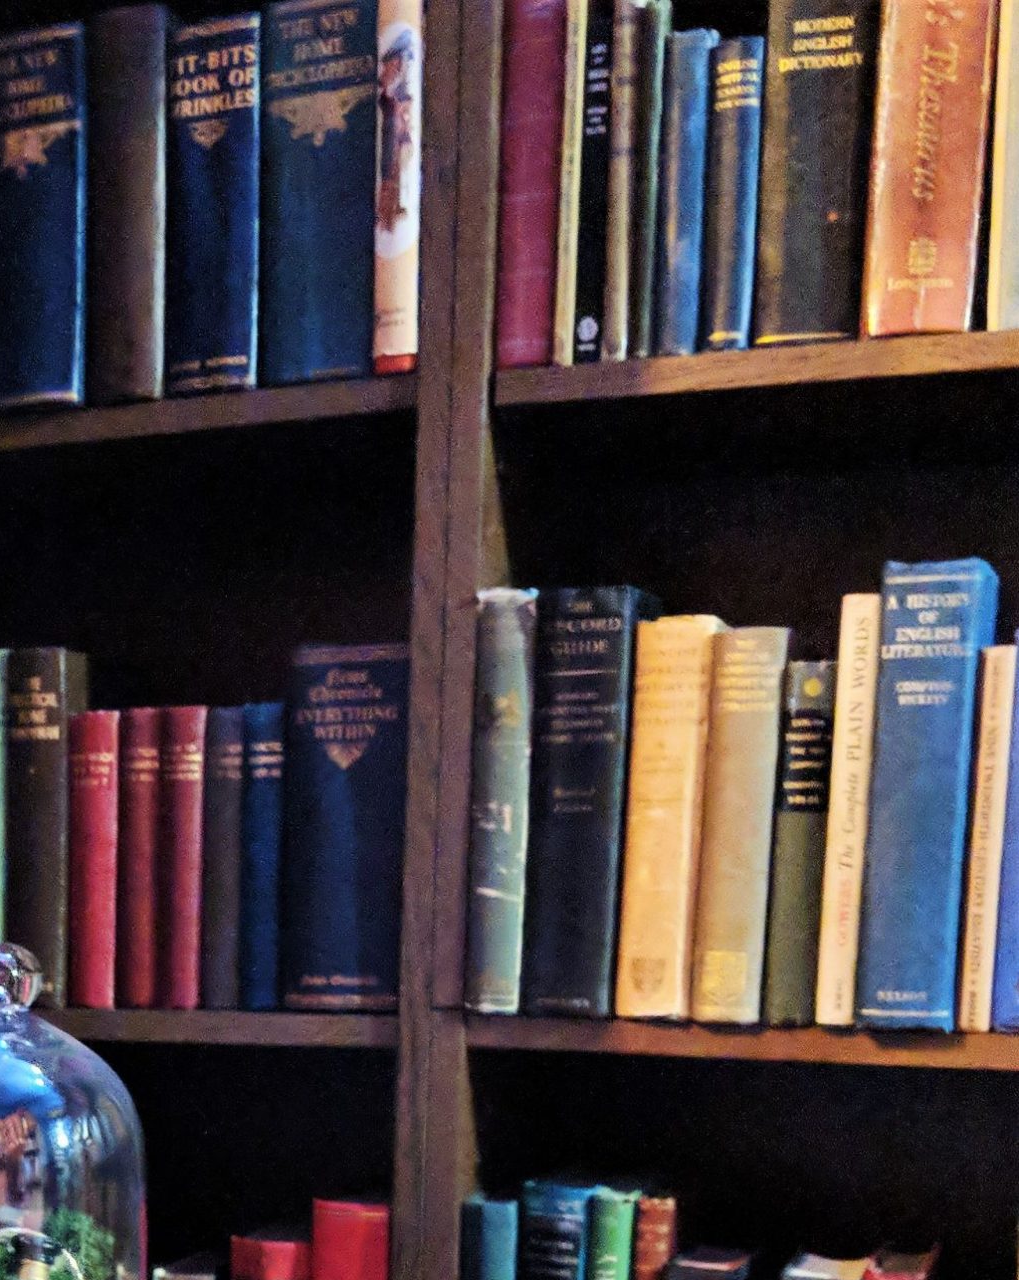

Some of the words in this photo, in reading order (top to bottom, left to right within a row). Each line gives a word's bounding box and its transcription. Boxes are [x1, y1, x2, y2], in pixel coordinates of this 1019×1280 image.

[793, 16, 856, 34] MODERN
[792, 35, 854, 52] ENGLISH
[176, 44, 257, 76] IT-BITS
[778, 51, 864, 73] DICTIONARY
[175, 75, 222, 97] OOK
[228, 67, 256, 88] OF
[175, 88, 256, 117] RINKLES
[910, 41, 959, 202] Thesaurus
[885, 594, 901, 611] A
[905, 592, 971, 610] HISTORY
[917, 609, 939, 625] OF
[894, 626, 961, 642] ENGLISH
[850, 615, 870, 691] WORDS
[880, 643, 976, 660] LITERATURE
[295, 706, 399, 725] EVERYTHING
[312, 723, 377, 741] WITHIN
[845, 700, 864, 763] PLAIN
[840, 773, 863, 836] Complete
[837, 846, 855, 871] The
